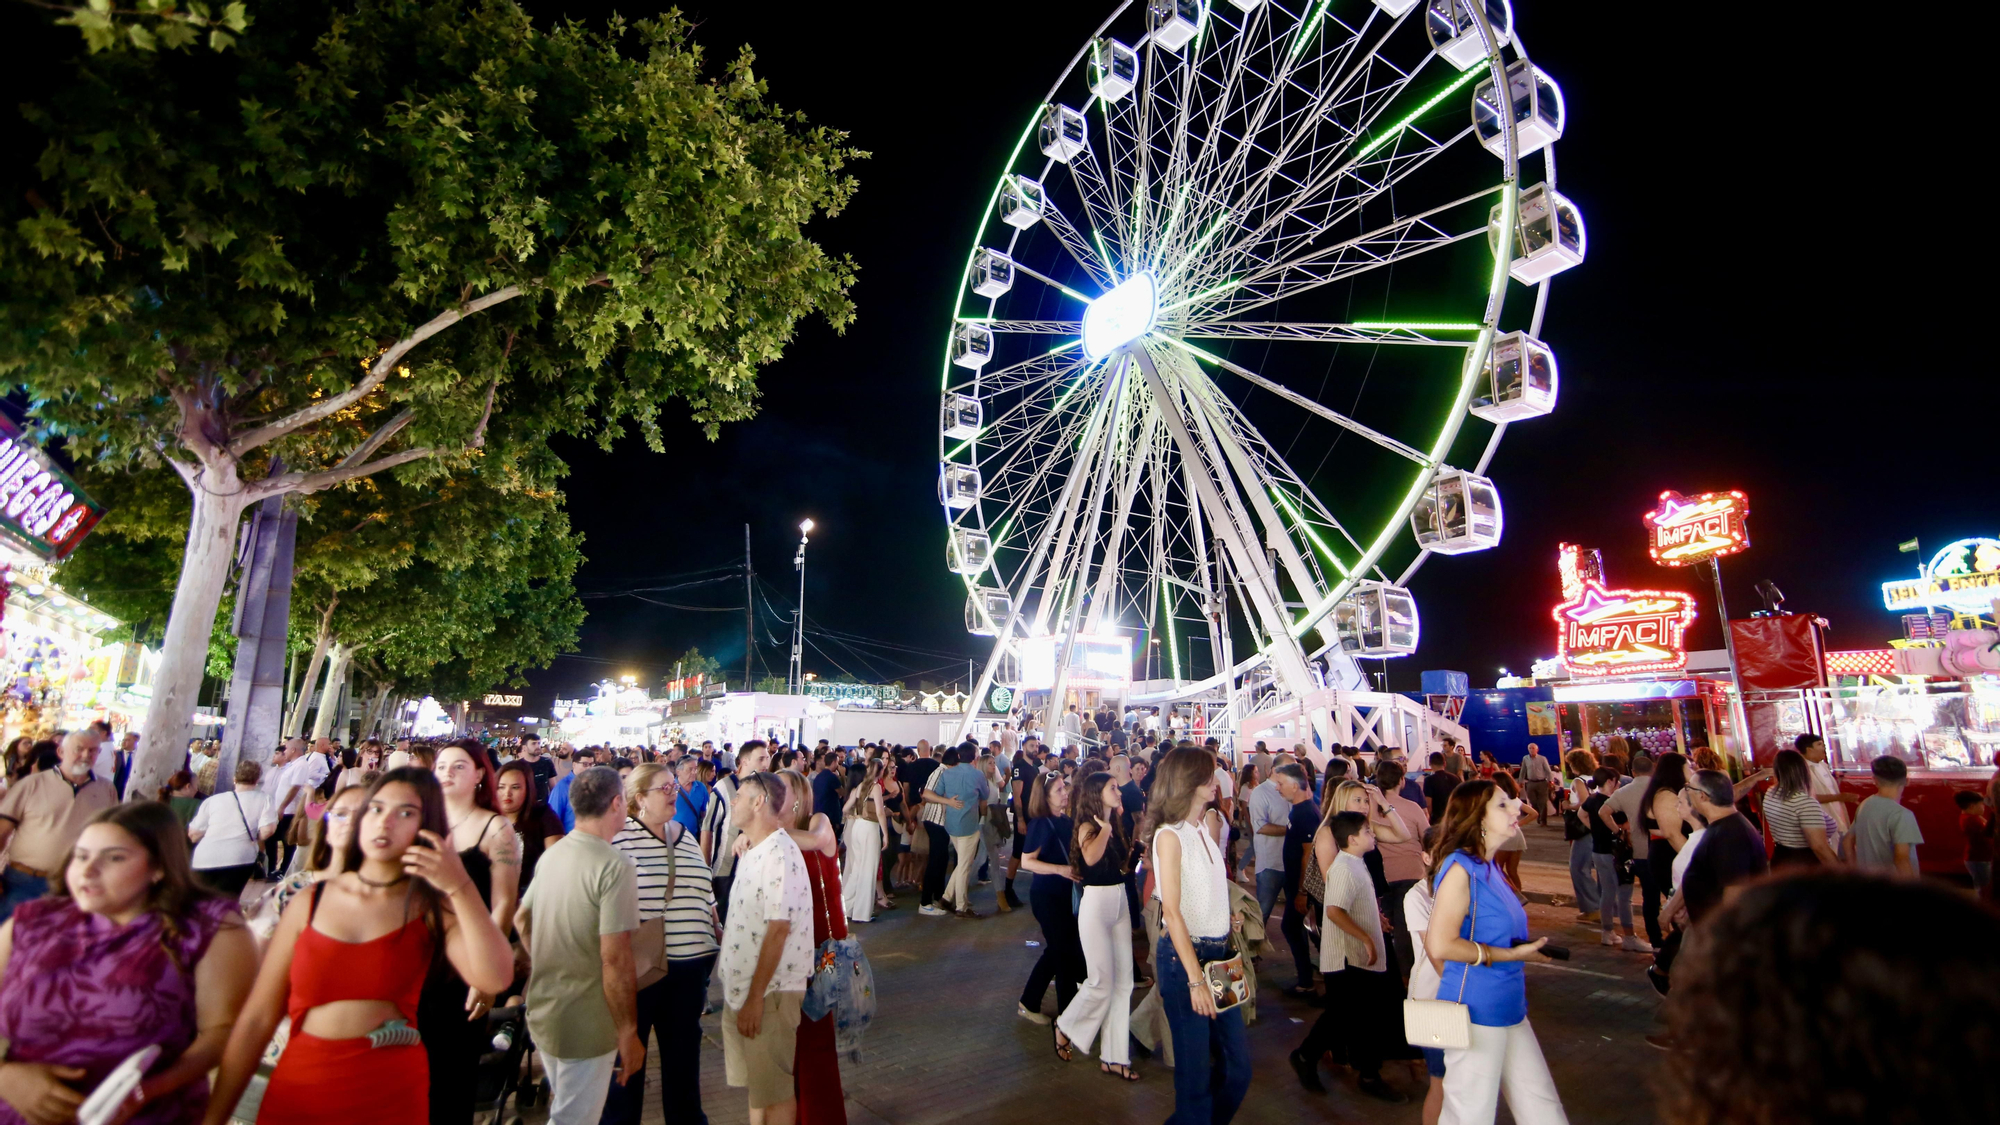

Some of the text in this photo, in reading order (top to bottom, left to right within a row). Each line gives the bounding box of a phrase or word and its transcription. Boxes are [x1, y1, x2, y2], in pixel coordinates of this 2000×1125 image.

[1657, 507, 1735, 547] IMPACT
[1568, 612, 1680, 650] IMPACT
[484, 694, 523, 707] TAXI
